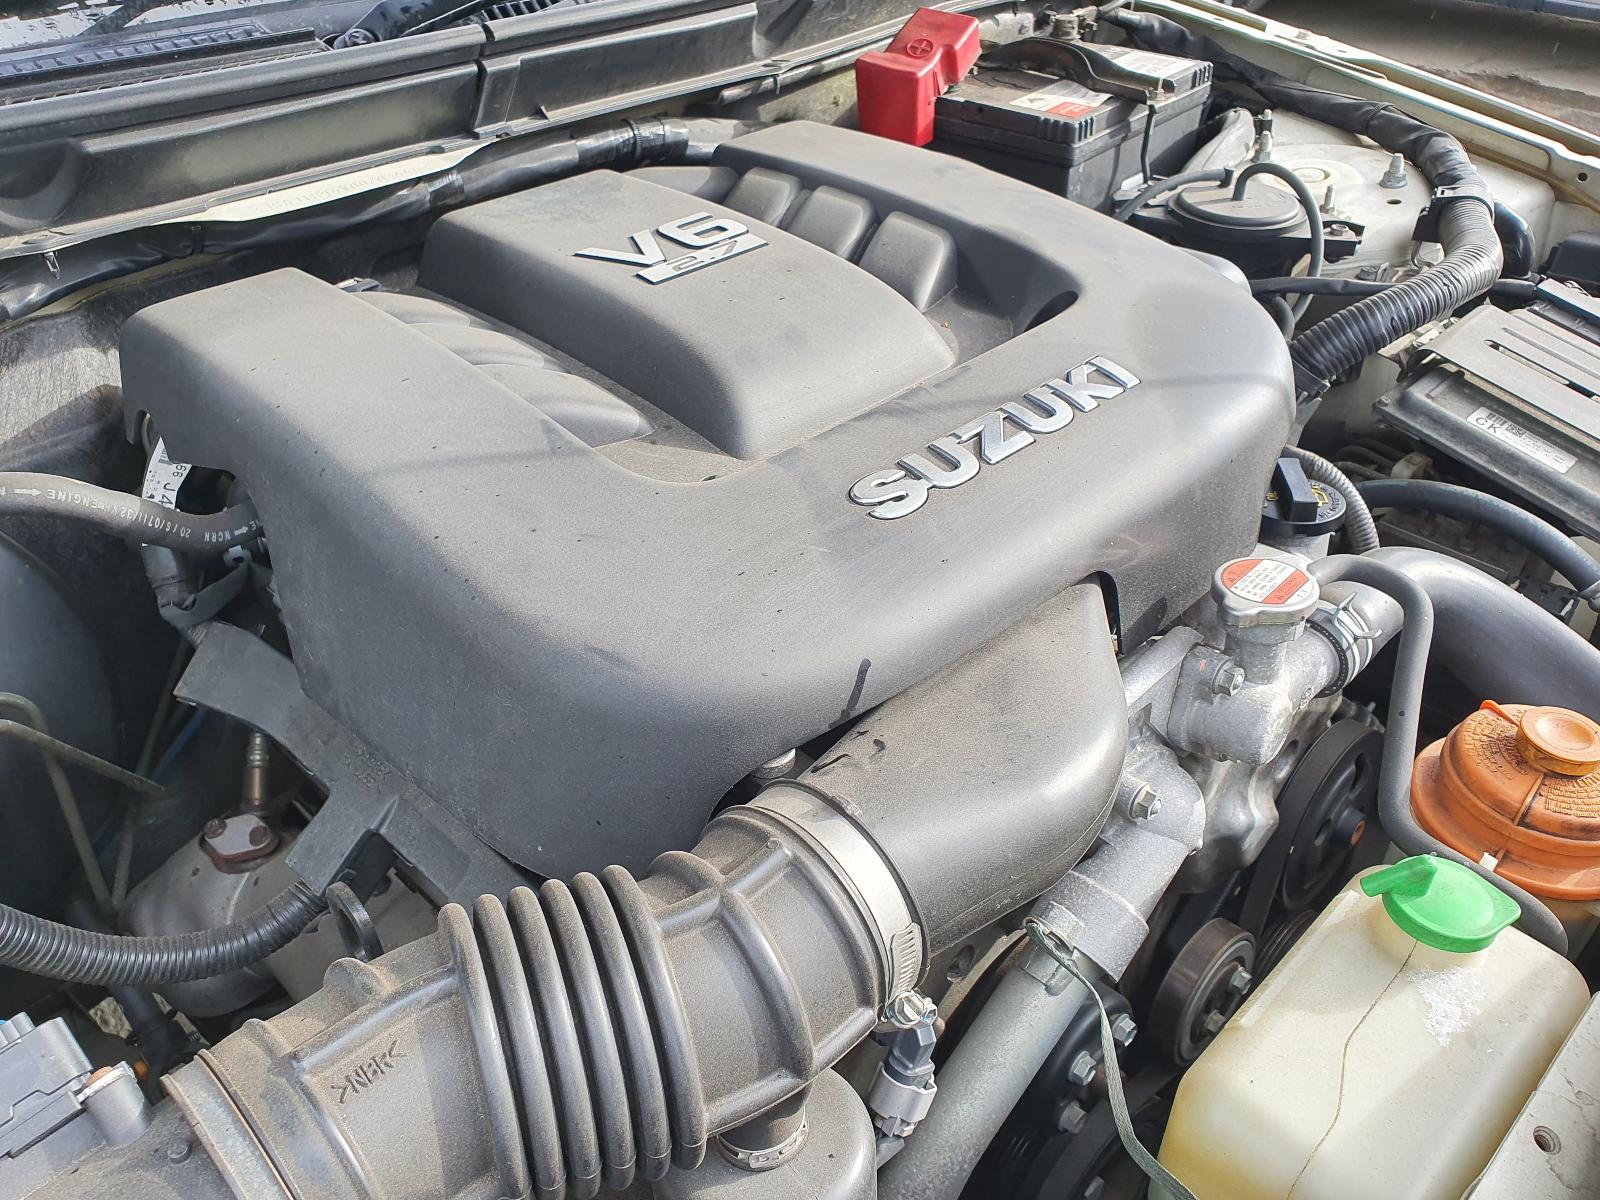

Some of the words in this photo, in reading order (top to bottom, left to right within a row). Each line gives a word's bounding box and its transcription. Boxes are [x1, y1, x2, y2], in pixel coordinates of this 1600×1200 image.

[573, 211, 748, 267] V6
[849, 355, 1142, 520] SUZUKI
[46, 488, 101, 508] ENGINE
